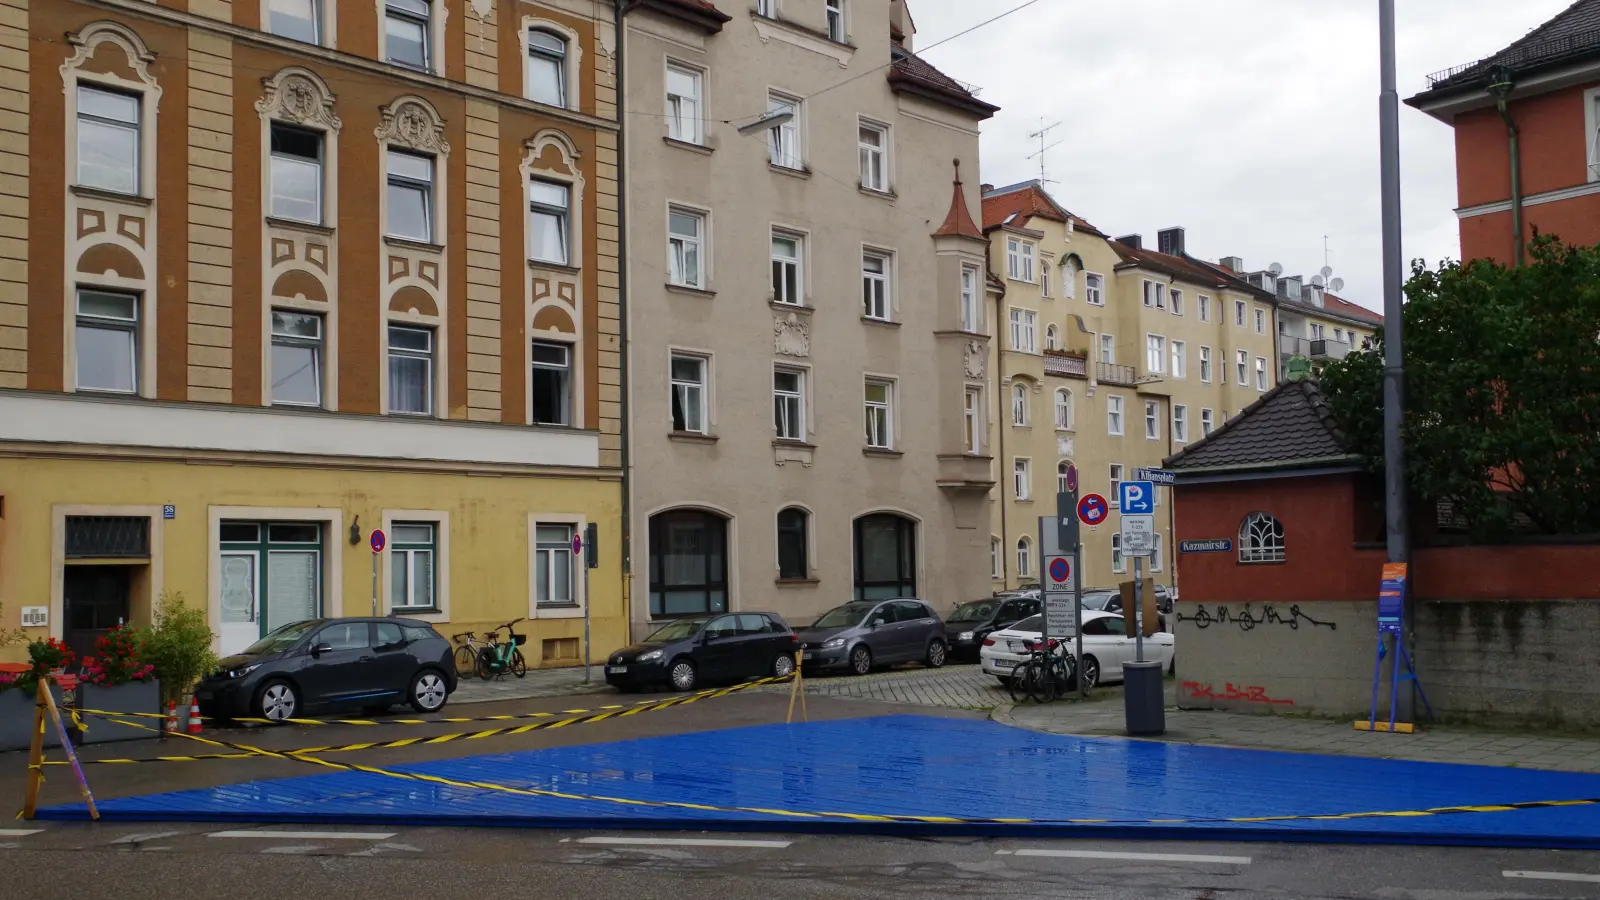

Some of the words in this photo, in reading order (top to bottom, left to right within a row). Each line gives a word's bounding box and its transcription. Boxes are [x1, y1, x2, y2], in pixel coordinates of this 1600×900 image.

[1140, 470, 1174, 483] Kiliansplatz
[1125, 486, 1143, 510] P
[1183, 541, 1228, 550] Kazmairstr.
